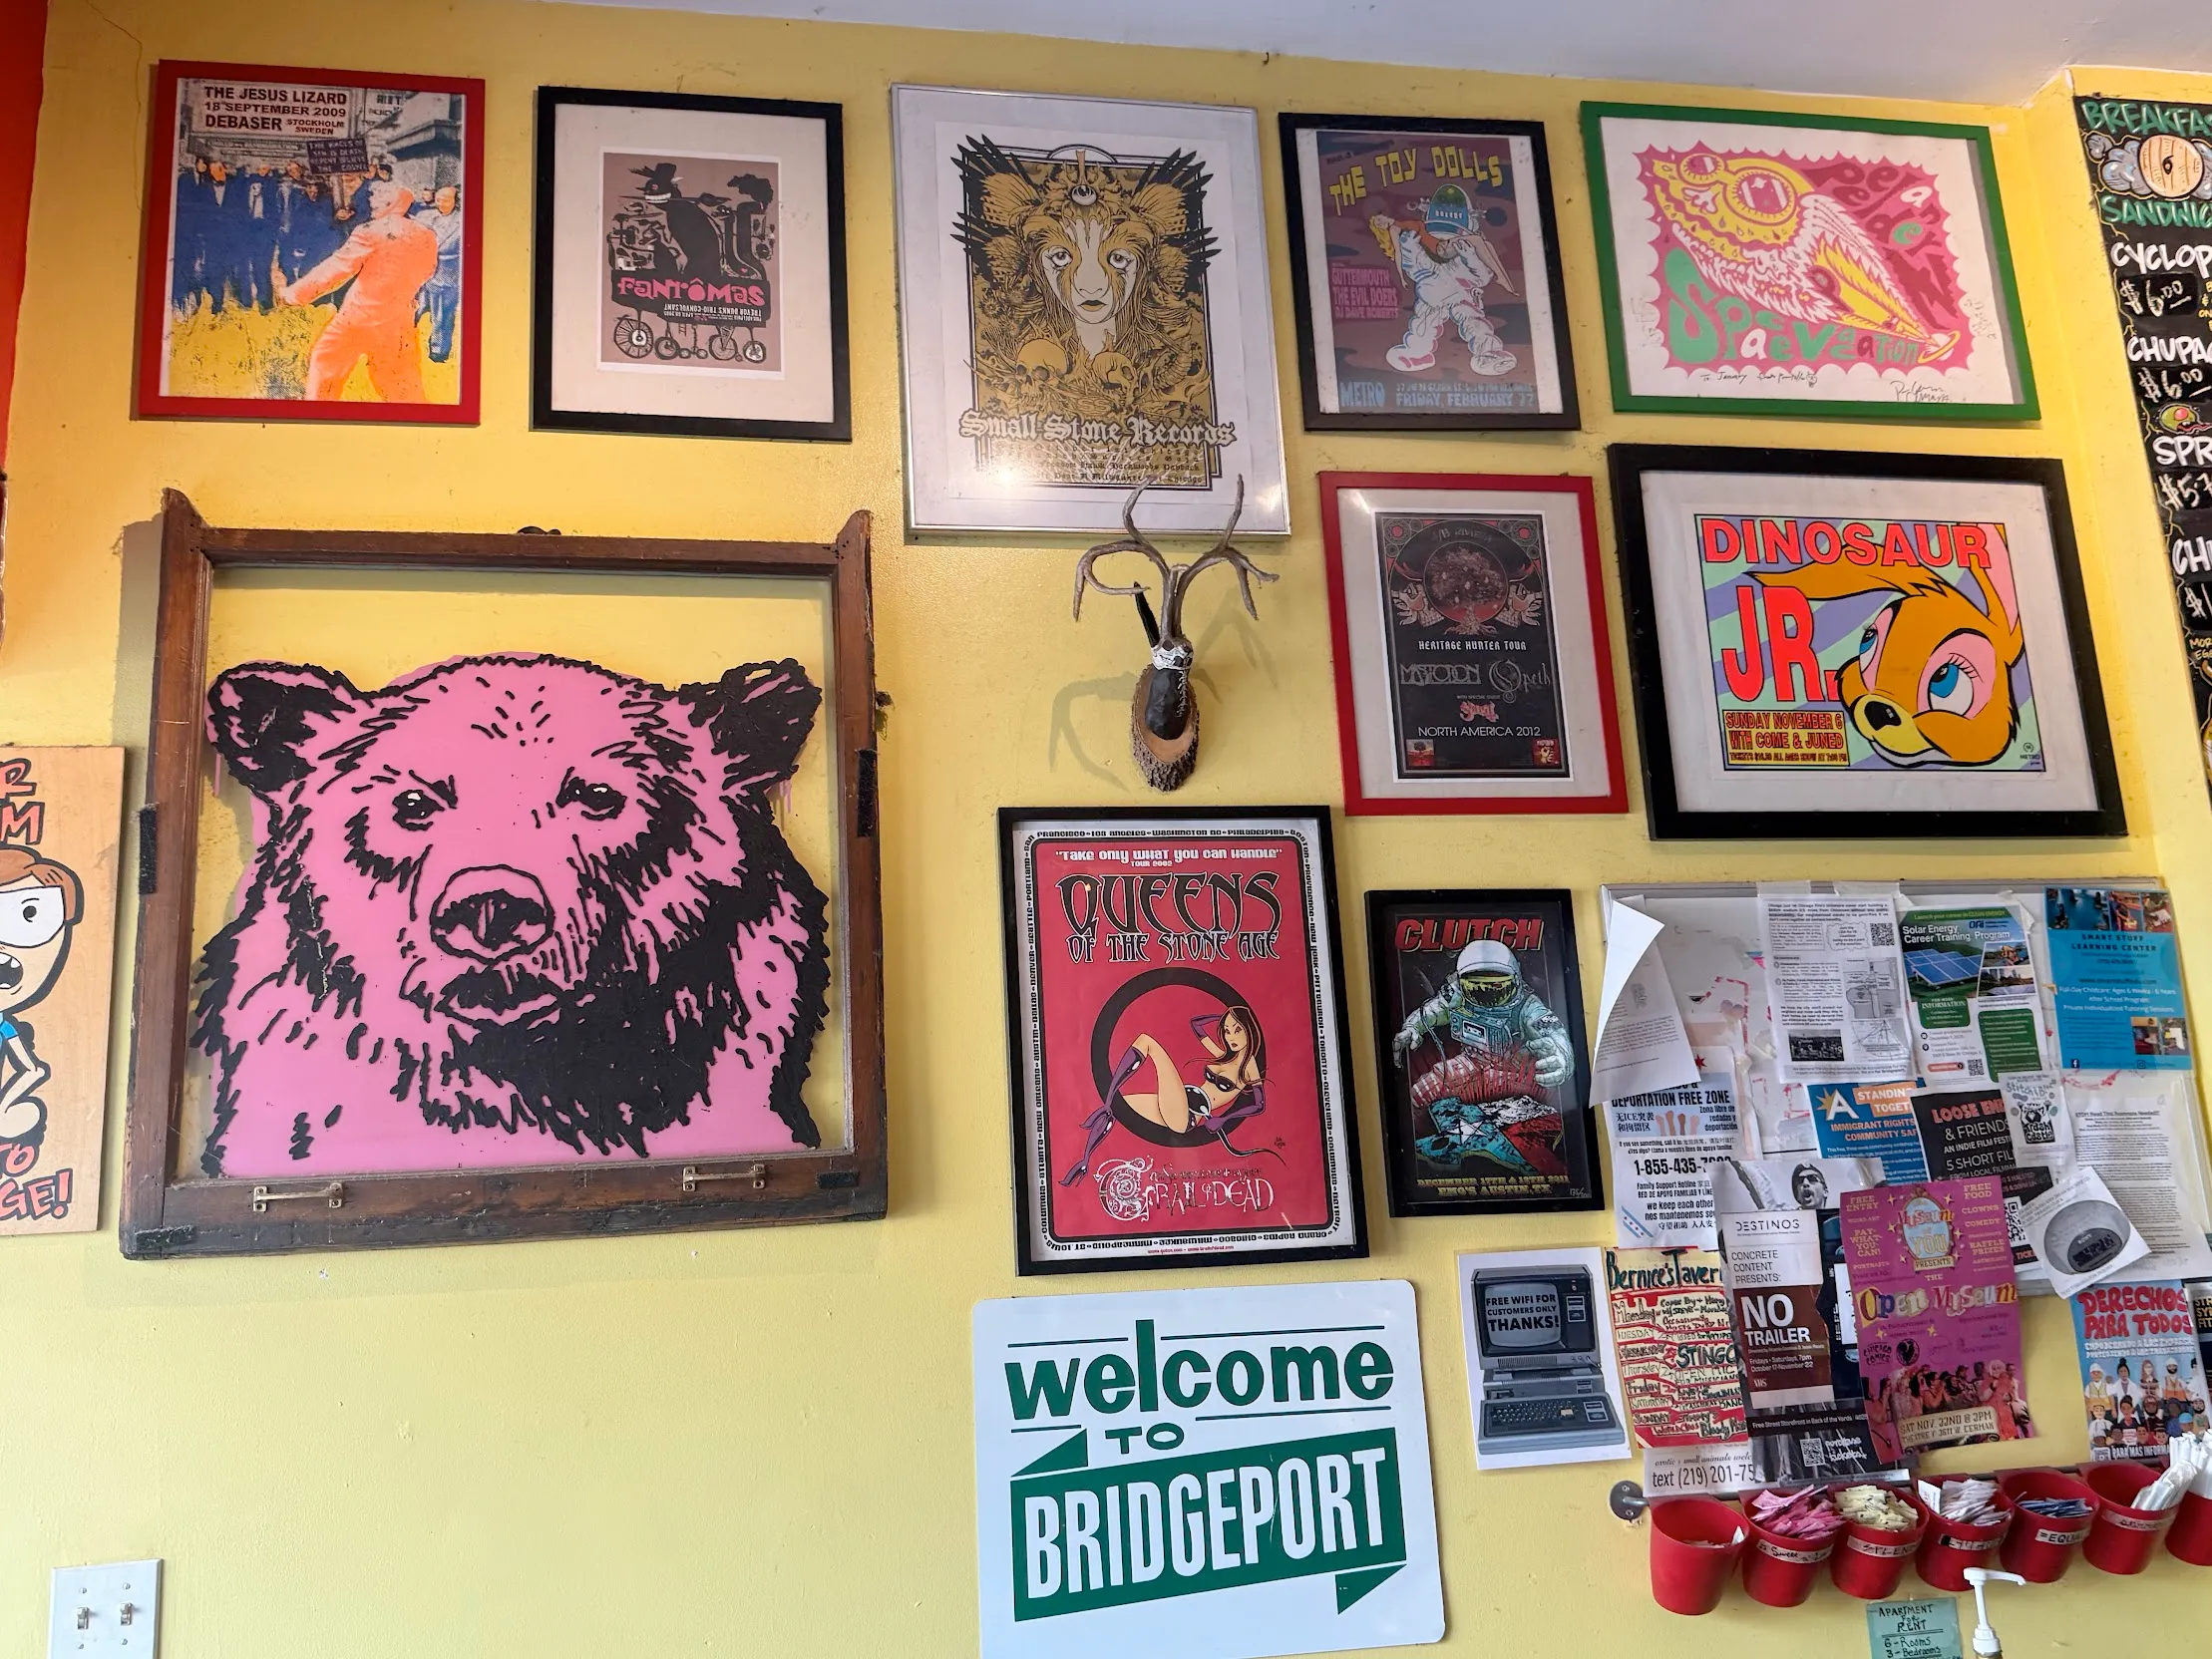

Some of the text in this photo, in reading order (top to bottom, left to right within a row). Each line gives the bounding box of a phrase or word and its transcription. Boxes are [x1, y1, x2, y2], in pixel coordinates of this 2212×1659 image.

[204, 87, 347, 105] THE JESUS LIZARD
[204, 103, 346, 118] 18 SEPTEMBER 2009
[205, 115, 345, 131] DEBASER STOCKHOLM
[295, 127, 334, 136] SWEDEN
[1328, 146, 1504, 216] THE TOY DOLLS
[2127, 336, 2212, 365] CHUPA
[1339, 382, 1385, 408] METRO
[1700, 517, 1992, 568] DINOSAUR
[1418, 640, 1527, 651] HERITAGE HUNTER TOUR
[1721, 586, 1841, 702] JR.
[1725, 712, 1843, 730] SUNDAY NOVEMBER 6
[1418, 727, 1541, 737] NORTH AMERICA 2012
[1728, 730, 1844, 750] WITH COME & JUNED
[1054, 871, 1283, 936] QUEENS
[1394, 918, 1544, 953] CLUTCH
[1903, 924, 1959, 935] Solar Energy
[1904, 930, 2011, 944] Career Training Program
[1066, 931, 1281, 964] OF THE STONE AGE
[1922, 1000, 1966, 1010] INFORMATION
[1678, 1091, 1702, 1105] FREE
[1706, 1090, 1730, 1104] ZONE
[1857, 1088, 1913, 1100] STANDIN
[1931, 1103, 1980, 1124] LOOSE
[1831, 1118, 1915, 1132] IMMIGRANT RIGHTS
[1945, 1119, 2010, 1141] & FRIENDS
[1845, 1130, 1899, 1142] COMMUNITY
[1956, 1142, 1976, 1152] INDIE
[1976, 1138, 1993, 1148] FILM
[1946, 1153, 1994, 1170] 5 SHORT
[1416, 1177, 1478, 1186] DECEMBER
[1637, 1181, 1655, 1190] Family
[1656, 1181, 1677, 1190] Support
[1963, 1182, 1992, 1191] FREE
[1213, 1177, 1274, 1212] DEAD
[1850, 1195, 1875, 1204] FREE
[1964, 1190, 1993, 1199] FOOD
[1659, 1200, 1675, 1210] keep
[1846, 1202, 1880, 1212] ENTRY
[1961, 1204, 2000, 1213] CLOWNS
[1659, 1211, 1703, 1220] mantenemos
[1965, 1218, 2002, 1227] COMEDY
[1735, 1219, 1800, 1231] DESTINOS
[1910, 1234, 1951, 1255] YOU
[1970, 1239, 2006, 1248] RAFFLE
[1972, 1246, 2005, 1255] PRIZES
[1731, 1250, 1779, 1261] CONCRETE
[1606, 1248, 1722, 1289] Bernice's Taver
[1733, 1262, 1772, 1272] CONTENT
[1916, 1258, 1952, 1268] PRESENTS
[1735, 1274, 1782, 1284] PRESENTS:
[1485, 1294, 1557, 1307] FREE WIFI FOR
[1857, 1286, 1929, 1321] Open
[2077, 1285, 2188, 1315] DERECHOS
[1487, 1305, 1557, 1317] CUSTOMERS ONLY
[1740, 1293, 1794, 1329] NO
[1488, 1315, 1560, 1332] THANKS!
[2084, 1313, 2193, 1339] PARA TODOS
[1744, 1327, 1811, 1346] TRAILER
[1004, 1319, 1394, 1421] welcome
[1900, 1423, 1915, 1435] SAT
[1105, 1422, 1185, 1455] TO
[1700, 1453, 1731, 1463] animals
[1653, 1474, 1674, 1488] text
[1678, 1467, 1708, 1489] (219)
[1024, 1447, 1386, 1599] BRIDGEPORT
[1879, 1604, 1934, 1616] APARTMENT
[1897, 1620, 1926, 1632] RENT
